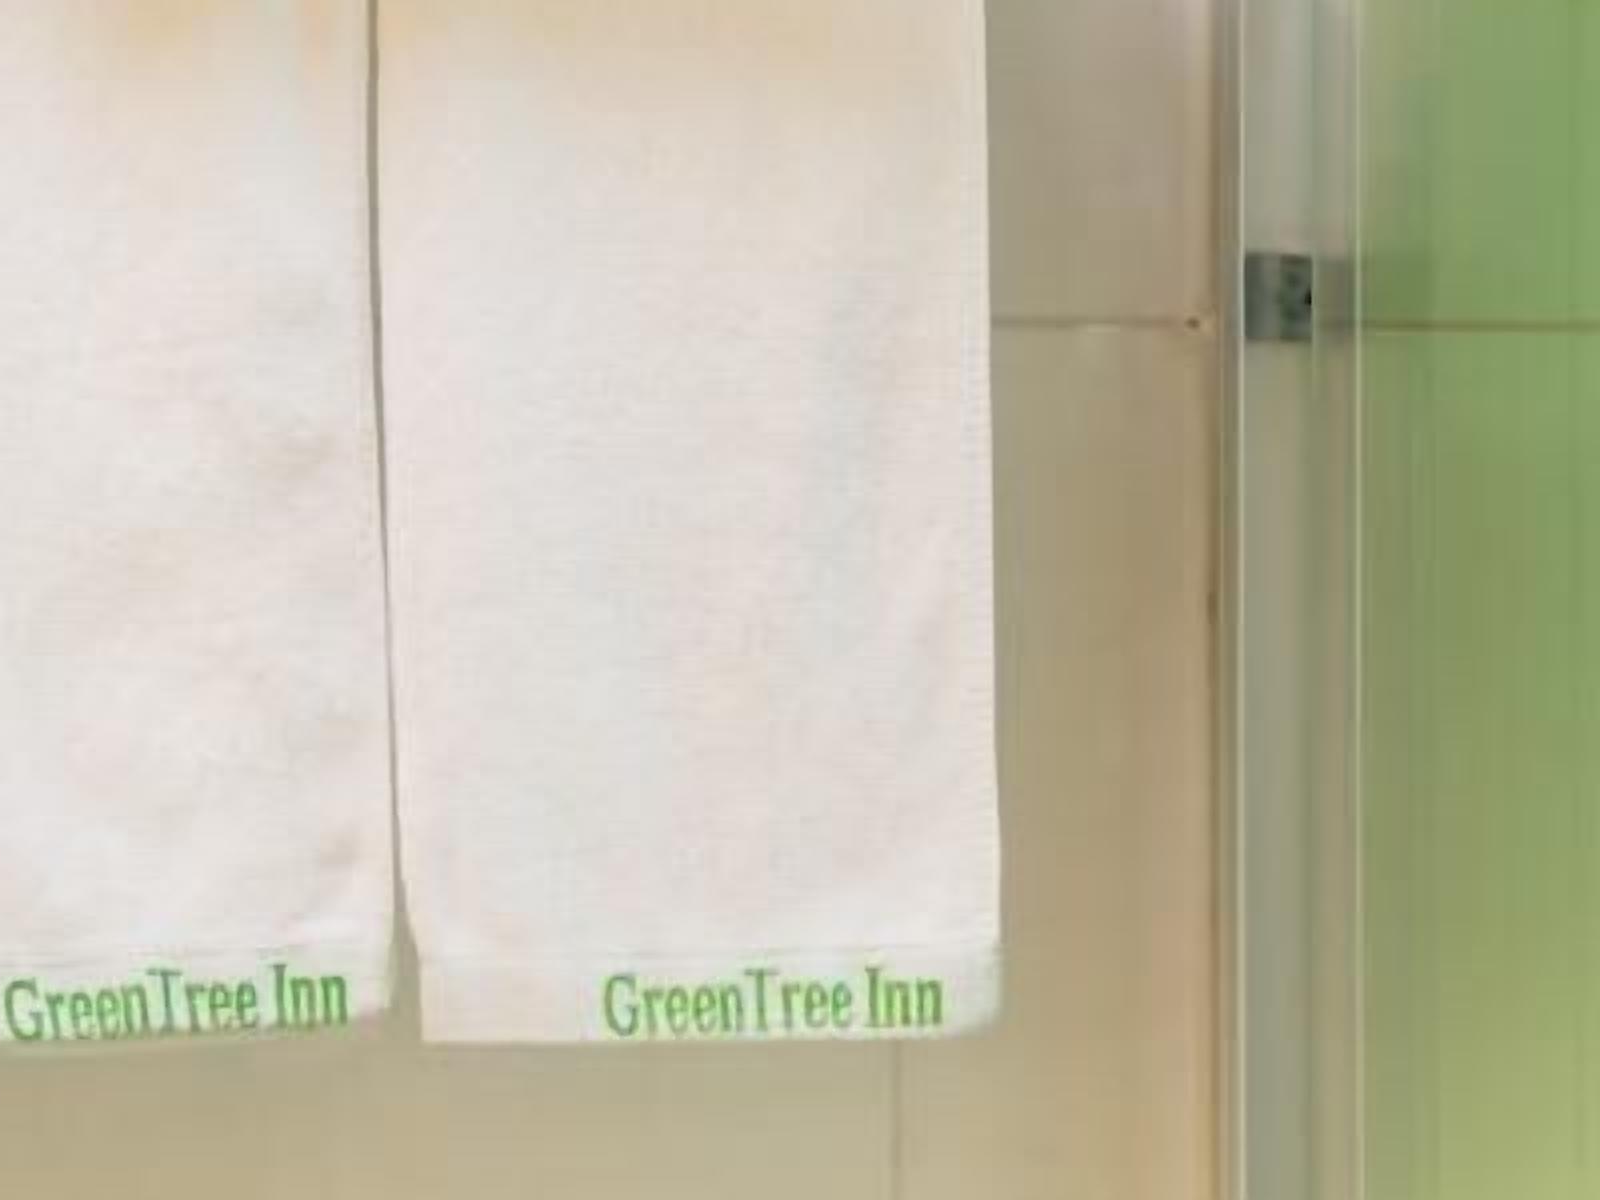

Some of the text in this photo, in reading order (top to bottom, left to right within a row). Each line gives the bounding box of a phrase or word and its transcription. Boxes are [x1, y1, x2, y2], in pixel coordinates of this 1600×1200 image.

[5, 963, 348, 1042] GreenTree Inn
[603, 966, 943, 1036] GreenTree Inn
